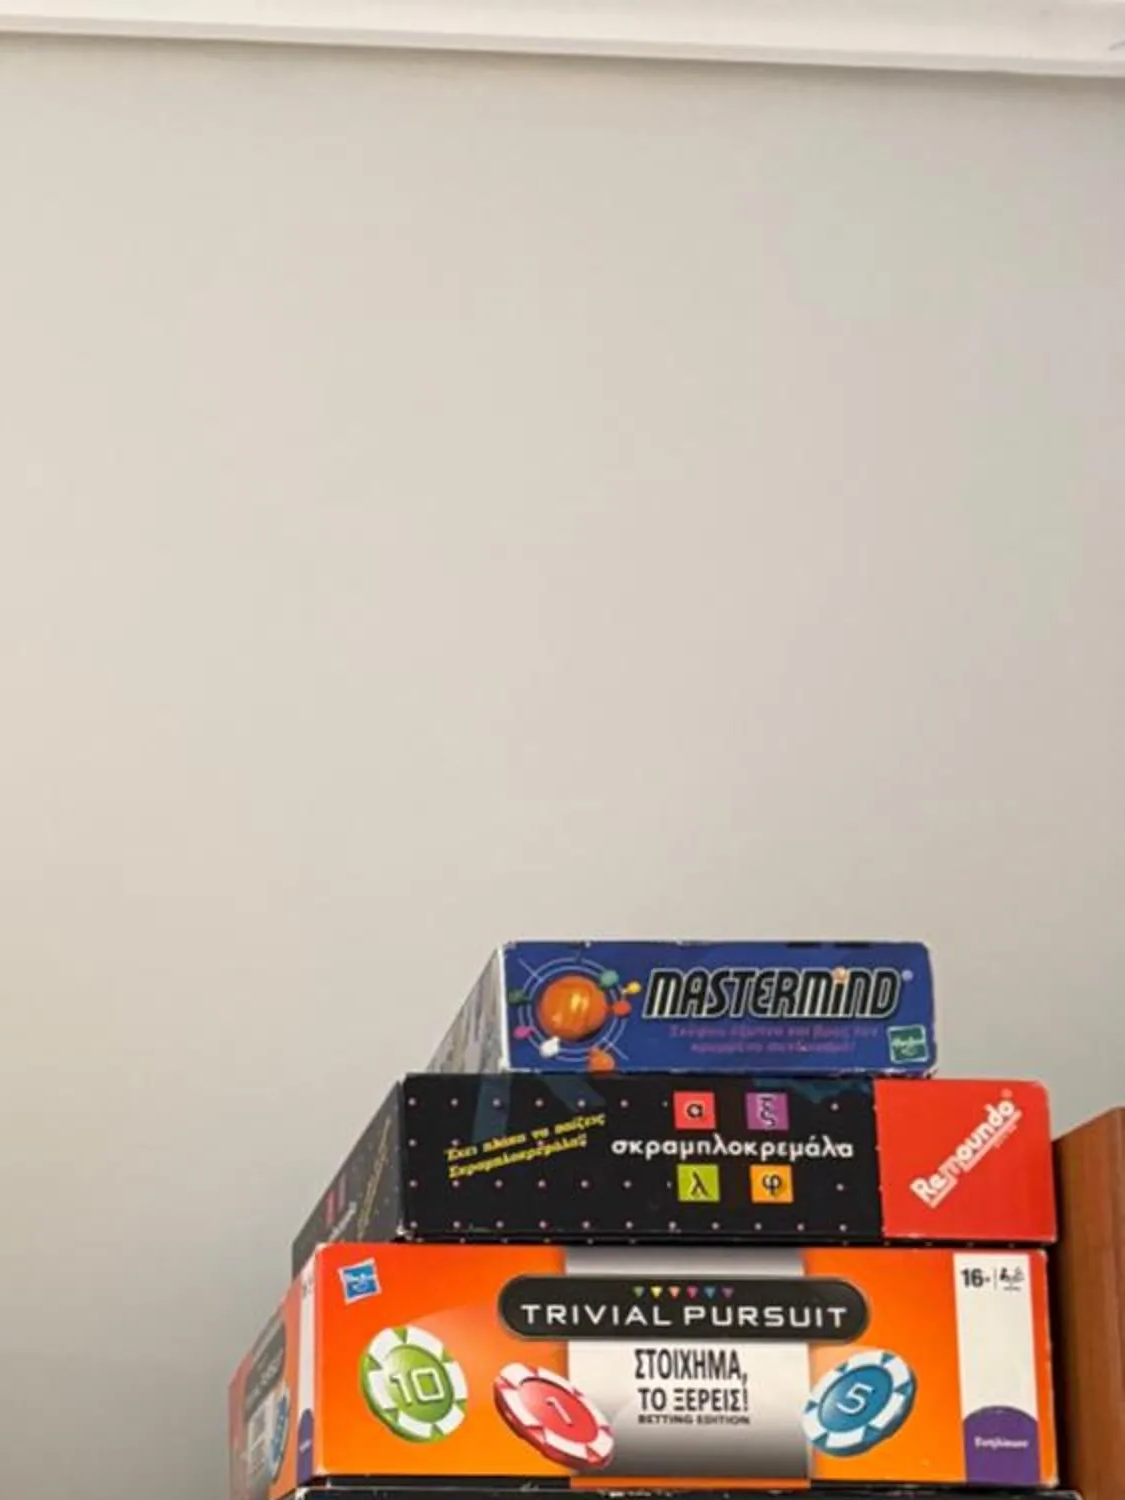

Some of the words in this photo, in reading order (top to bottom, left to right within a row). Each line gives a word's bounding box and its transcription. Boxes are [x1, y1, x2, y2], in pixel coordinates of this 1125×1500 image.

[611, 1134, 854, 1159] σκραμπλοκρεμάλα
[520, 1304, 671, 1326] TRIVIAL
[684, 1306, 848, 1328] PURSUIT
[634, 1348, 749, 1386] ΣΤΟΙΧΗΜΑ,
[390, 1368, 445, 1406] 10
[836, 1383, 874, 1414] 5
[638, 1388, 669, 1411] ΤΟ
[672, 1388, 750, 1413] ΞΕΡΕΙΣ!
[638, 1415, 693, 1425] BETTING
[697, 1415, 751, 1426] EDITION
